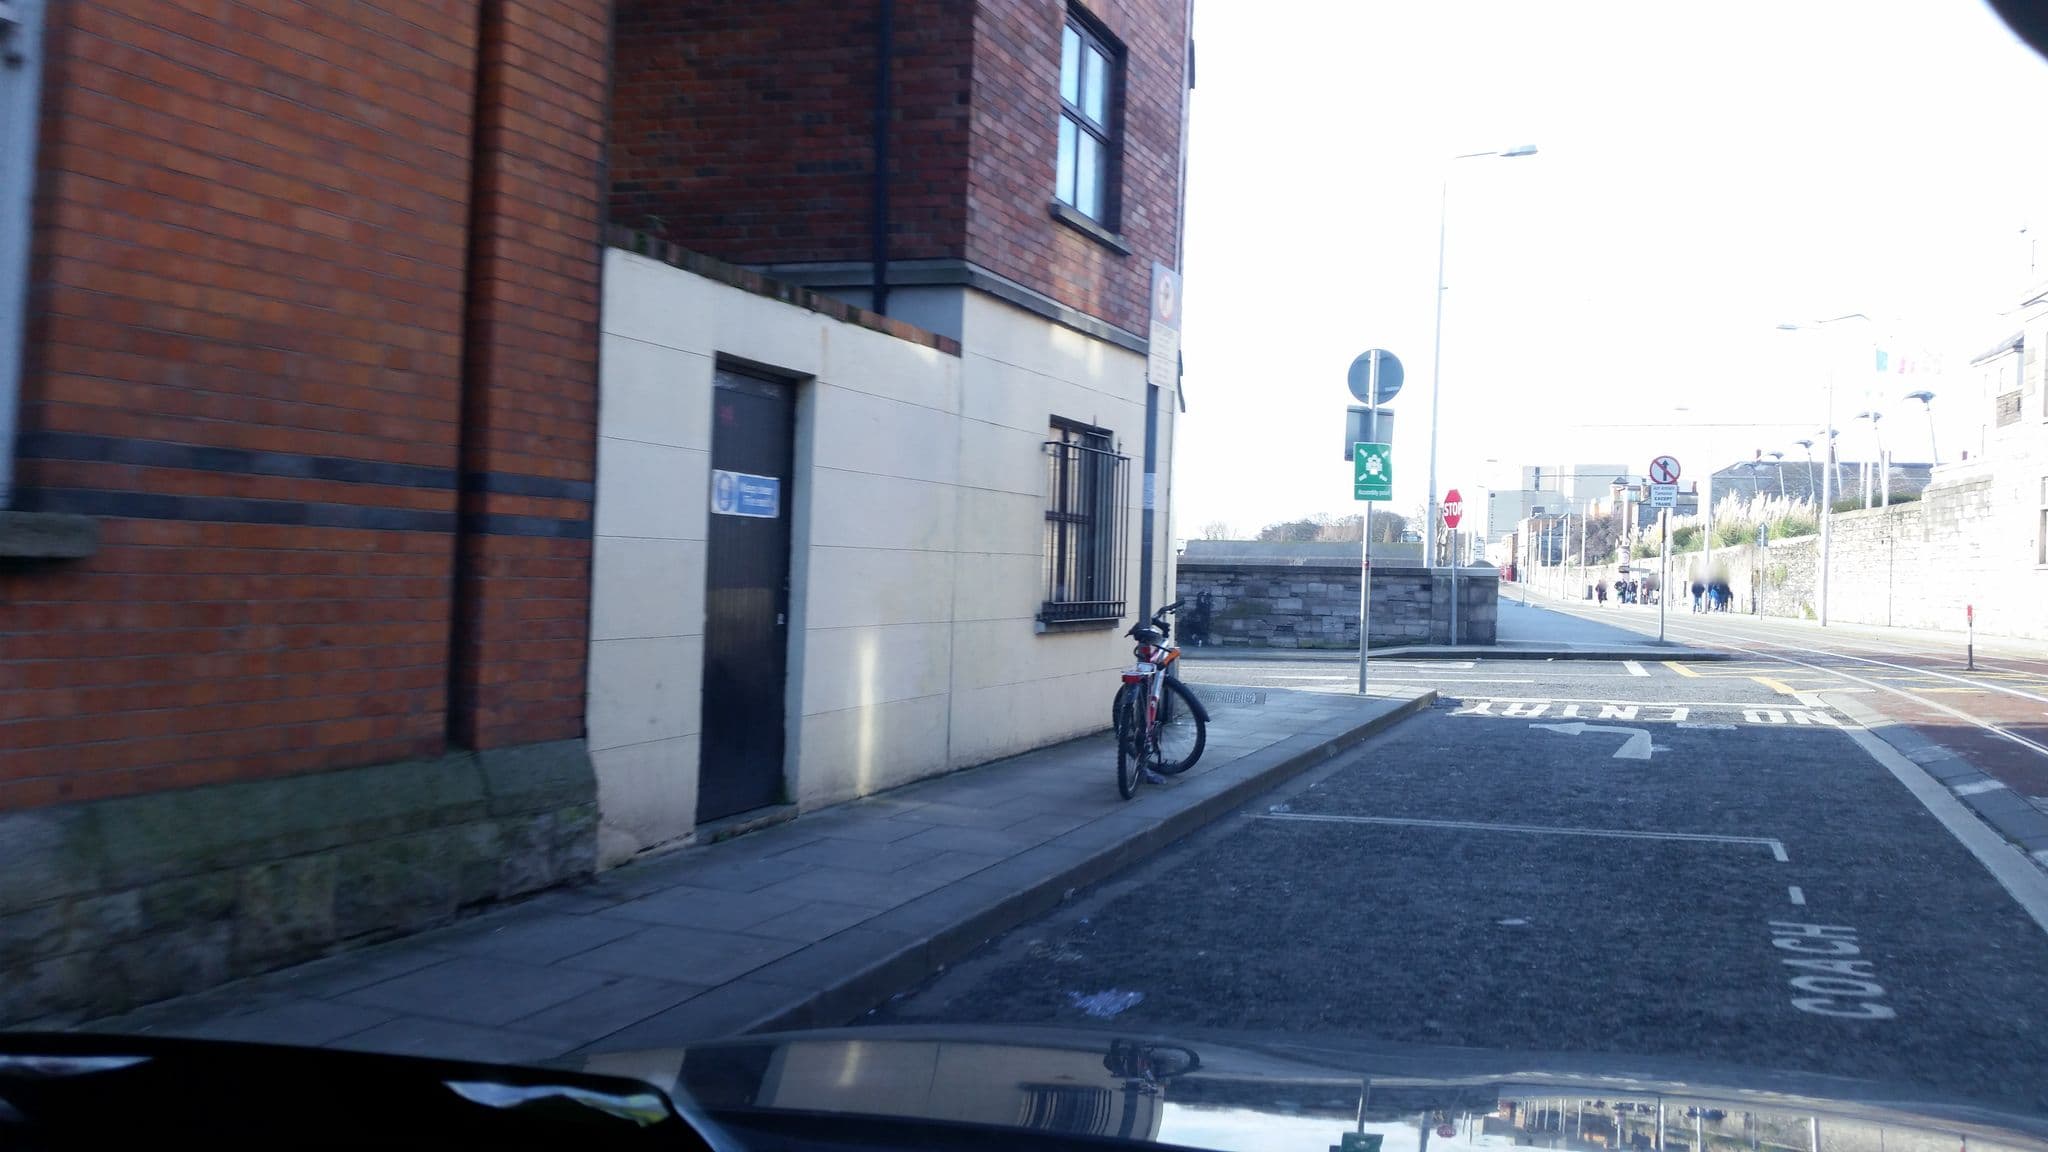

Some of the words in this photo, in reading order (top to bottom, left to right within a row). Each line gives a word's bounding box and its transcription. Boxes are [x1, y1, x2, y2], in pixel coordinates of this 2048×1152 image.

[1443, 502, 1463, 517] STOP
[1446, 702, 1690, 723] ENTRY
[1743, 708, 1838, 726] NO
[1768, 921, 1897, 1019] COACH
